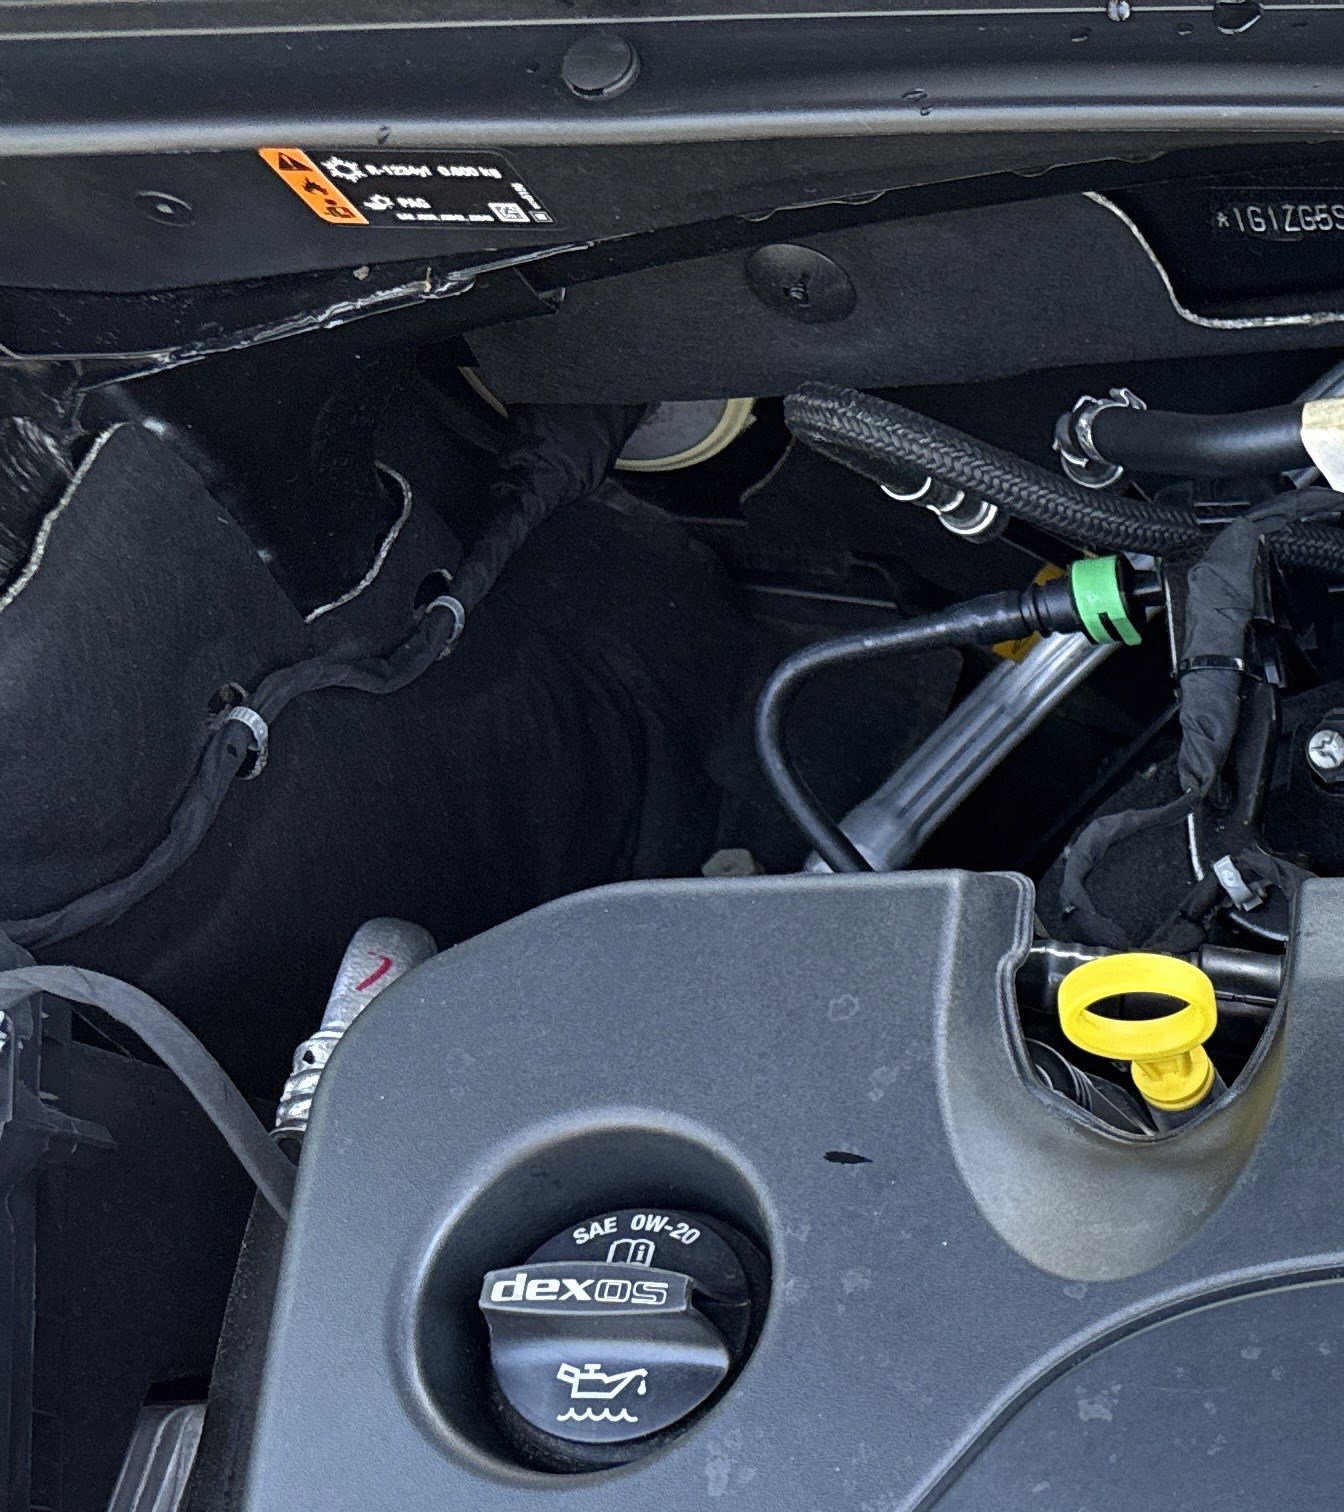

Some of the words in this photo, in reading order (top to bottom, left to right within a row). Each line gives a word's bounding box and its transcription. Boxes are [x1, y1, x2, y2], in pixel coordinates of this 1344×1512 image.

[573, 1216, 618, 1245] SAE
[630, 1214, 701, 1245] 0W-20
[490, 1273, 669, 1305] dexos
